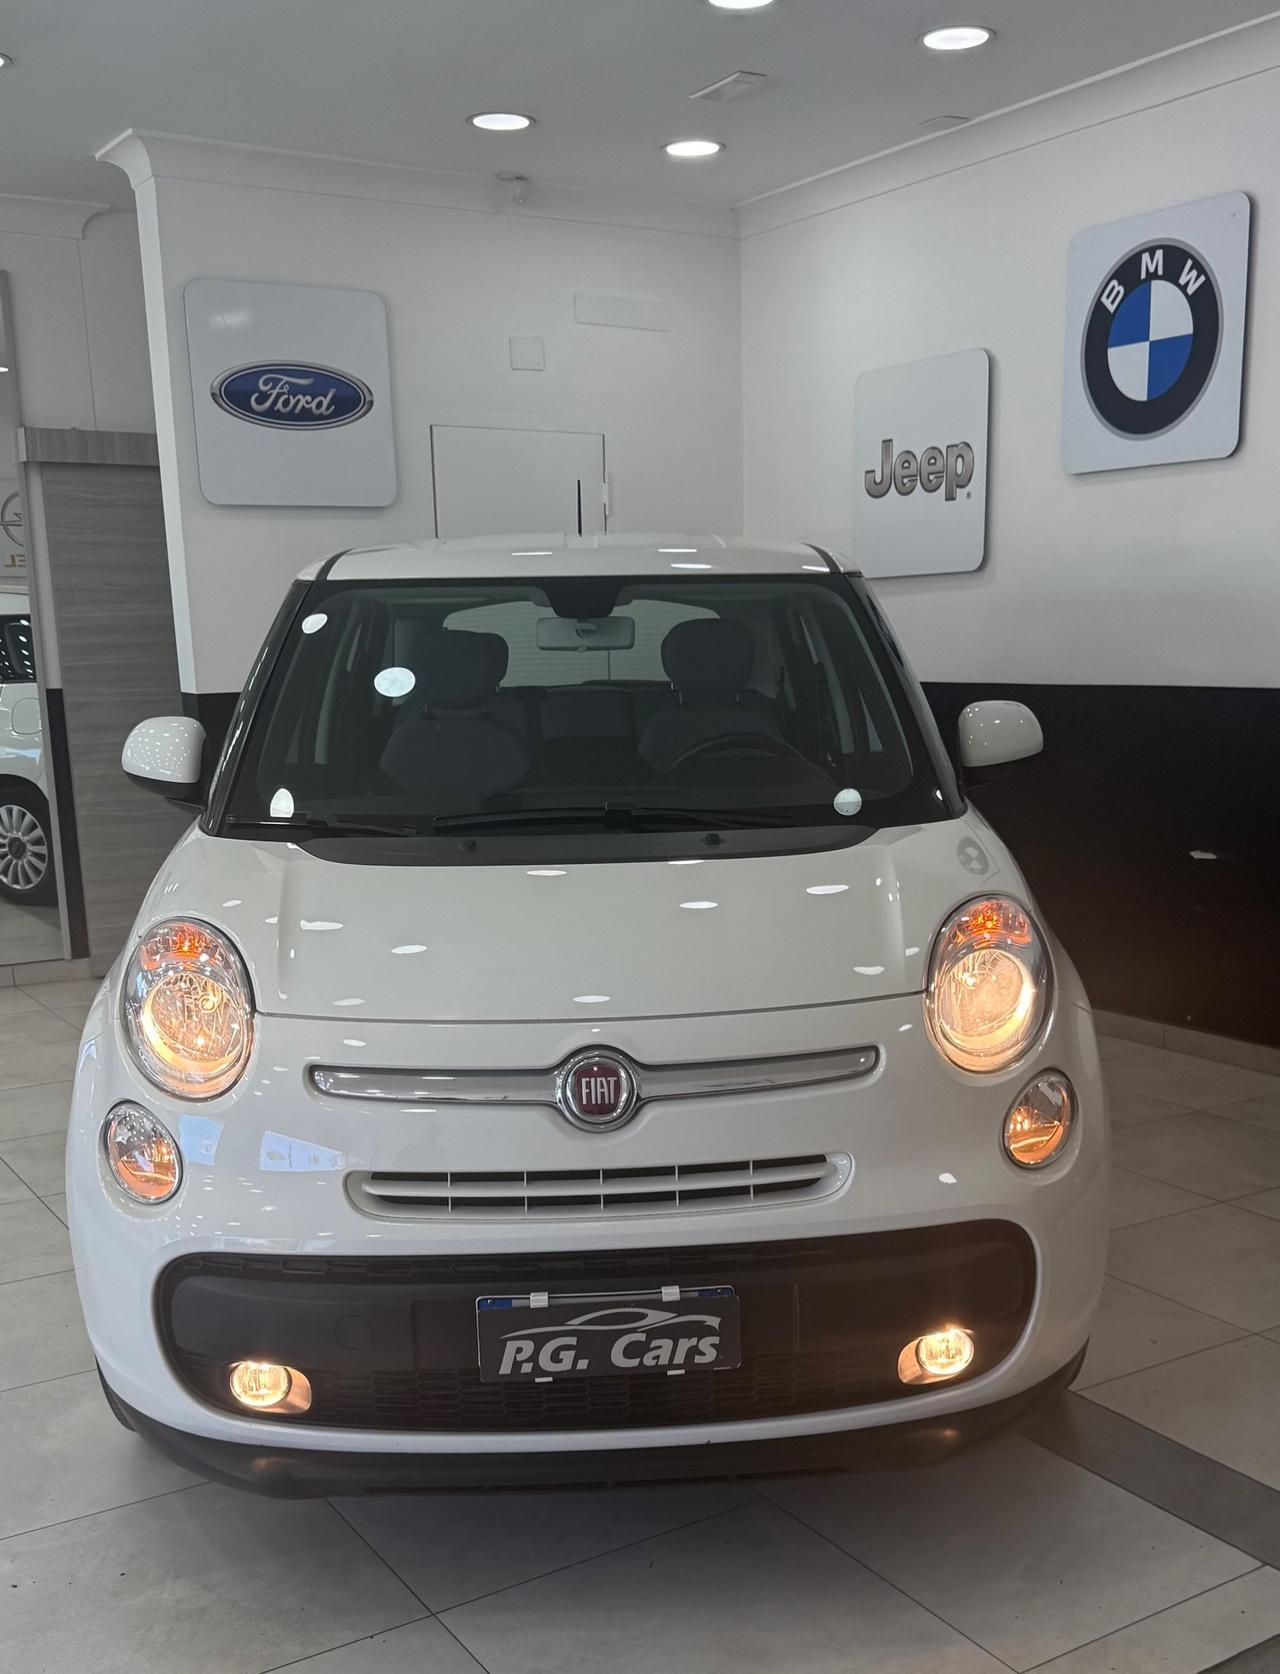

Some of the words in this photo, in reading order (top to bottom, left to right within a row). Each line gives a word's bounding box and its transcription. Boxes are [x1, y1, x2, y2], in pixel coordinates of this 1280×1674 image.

[1100, 249, 1206, 314] BMW
[250, 373, 336, 416] Ford
[864, 438, 975, 502] Jeep
[581, 1076, 618, 1105] FIAT
[498, 1336, 590, 1375] P.G.
[610, 1332, 721, 1369] Cars
